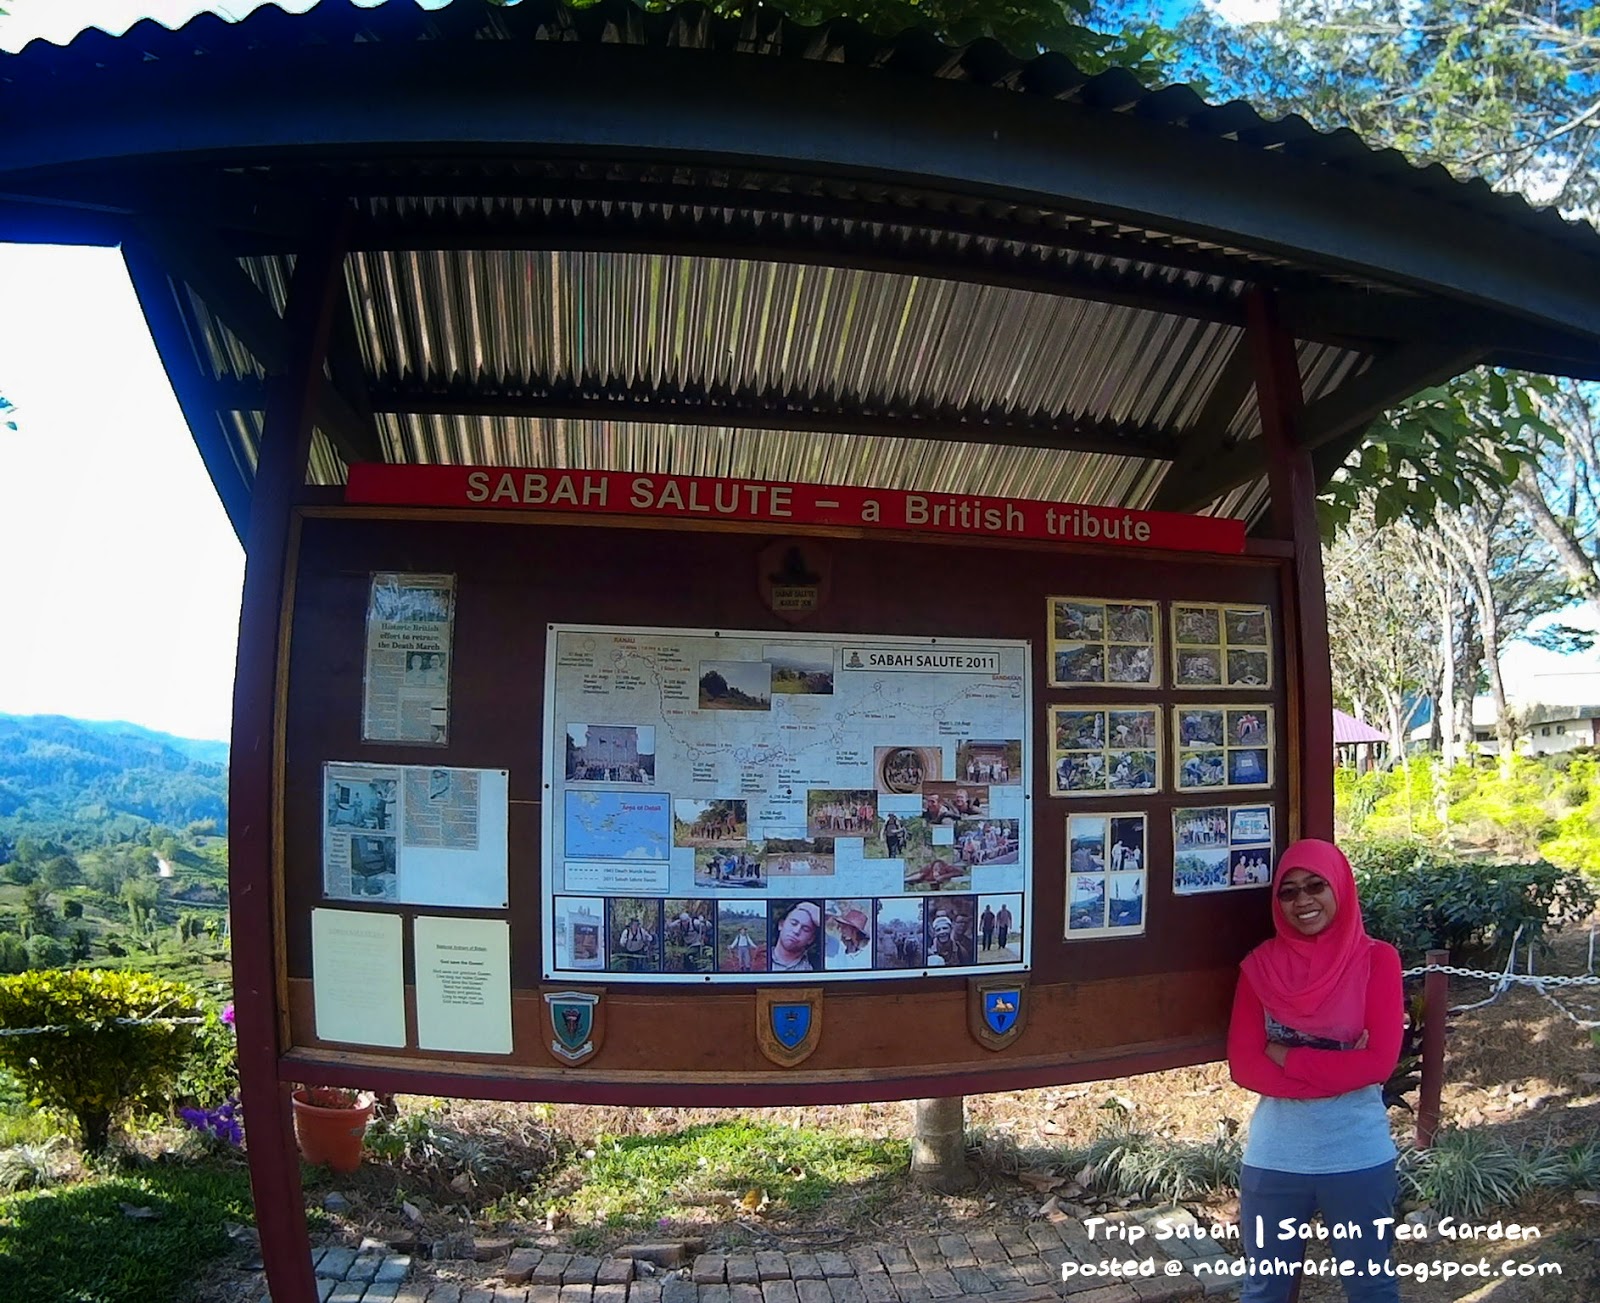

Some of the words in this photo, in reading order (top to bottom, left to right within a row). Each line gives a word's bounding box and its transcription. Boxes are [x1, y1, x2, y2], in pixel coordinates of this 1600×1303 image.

[466, 472, 608, 507] SABAH
[630, 478, 793, 517] SALUTE
[861, 500, 880, 522] a
[905, 495, 1025, 532] British
[1045, 507, 1151, 541] tribute
[381, 623, 411, 632] Historic
[413, 624, 439, 632] British
[380, 632, 401, 641] effort
[378, 641, 392, 649] the
[392, 641, 415, 650] Death
[869, 653, 913, 667] SABAH
[916, 654, 963, 669] SALUTE
[966, 656, 995, 669] 2011
